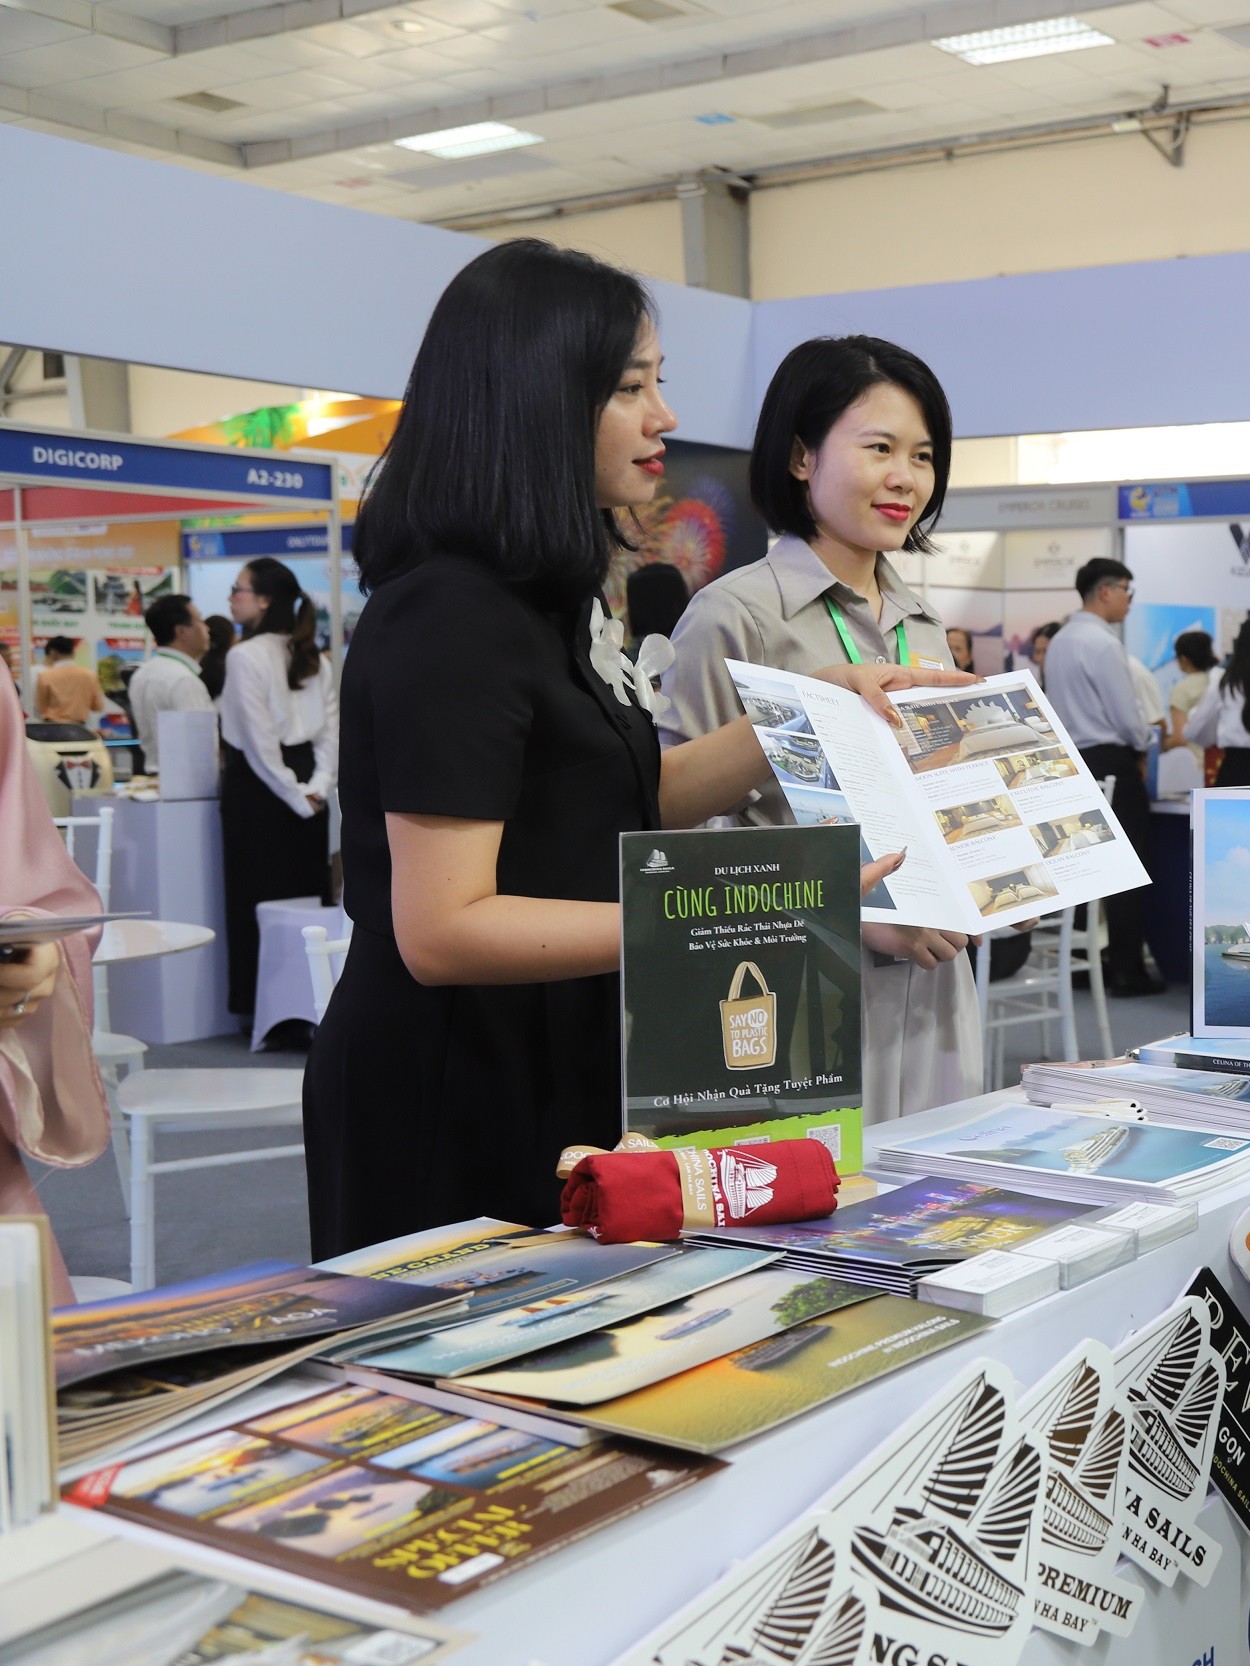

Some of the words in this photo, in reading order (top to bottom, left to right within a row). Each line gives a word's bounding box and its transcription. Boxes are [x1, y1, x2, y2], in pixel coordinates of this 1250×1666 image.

[32, 446, 123, 471] DIGICORP
[801, 690, 840, 707] FACTSHEET
[714, 867, 729, 875] DU
[730, 865, 752, 877] LỊCH
[753, 863, 780, 872] XANH
[664, 885, 717, 920] CÙNG
[724, 880, 824, 915] INDOCHINE
[737, 923, 752, 933] Rác
[705, 939, 716, 951] Vệ
[754, 936, 762, 945] &
[779, 933, 807, 944] Trường
[729, 1014, 748, 1029] SAY
[749, 1010, 765, 1027] NO
[730, 1030, 740, 1039] TO
[742, 1027, 768, 1038] PLASTIC
[732, 1037, 767, 1057] BAGS
[1212, 1058, 1234, 1067] CELINA
[653, 1096, 670, 1107] Cơ
[673, 1094, 694, 1106] Hội
[697, 1089, 726, 1102] Nhận
[754, 1083, 781, 1096] Tặng
[783, 1076, 813, 1091] Tuyệt
[695, 1178, 707, 1211] SAILS
[1131, 1533, 1148, 1554] HA
[1144, 1507, 1207, 1567] SAILS
[1040, 1602, 1059, 1621] HA
